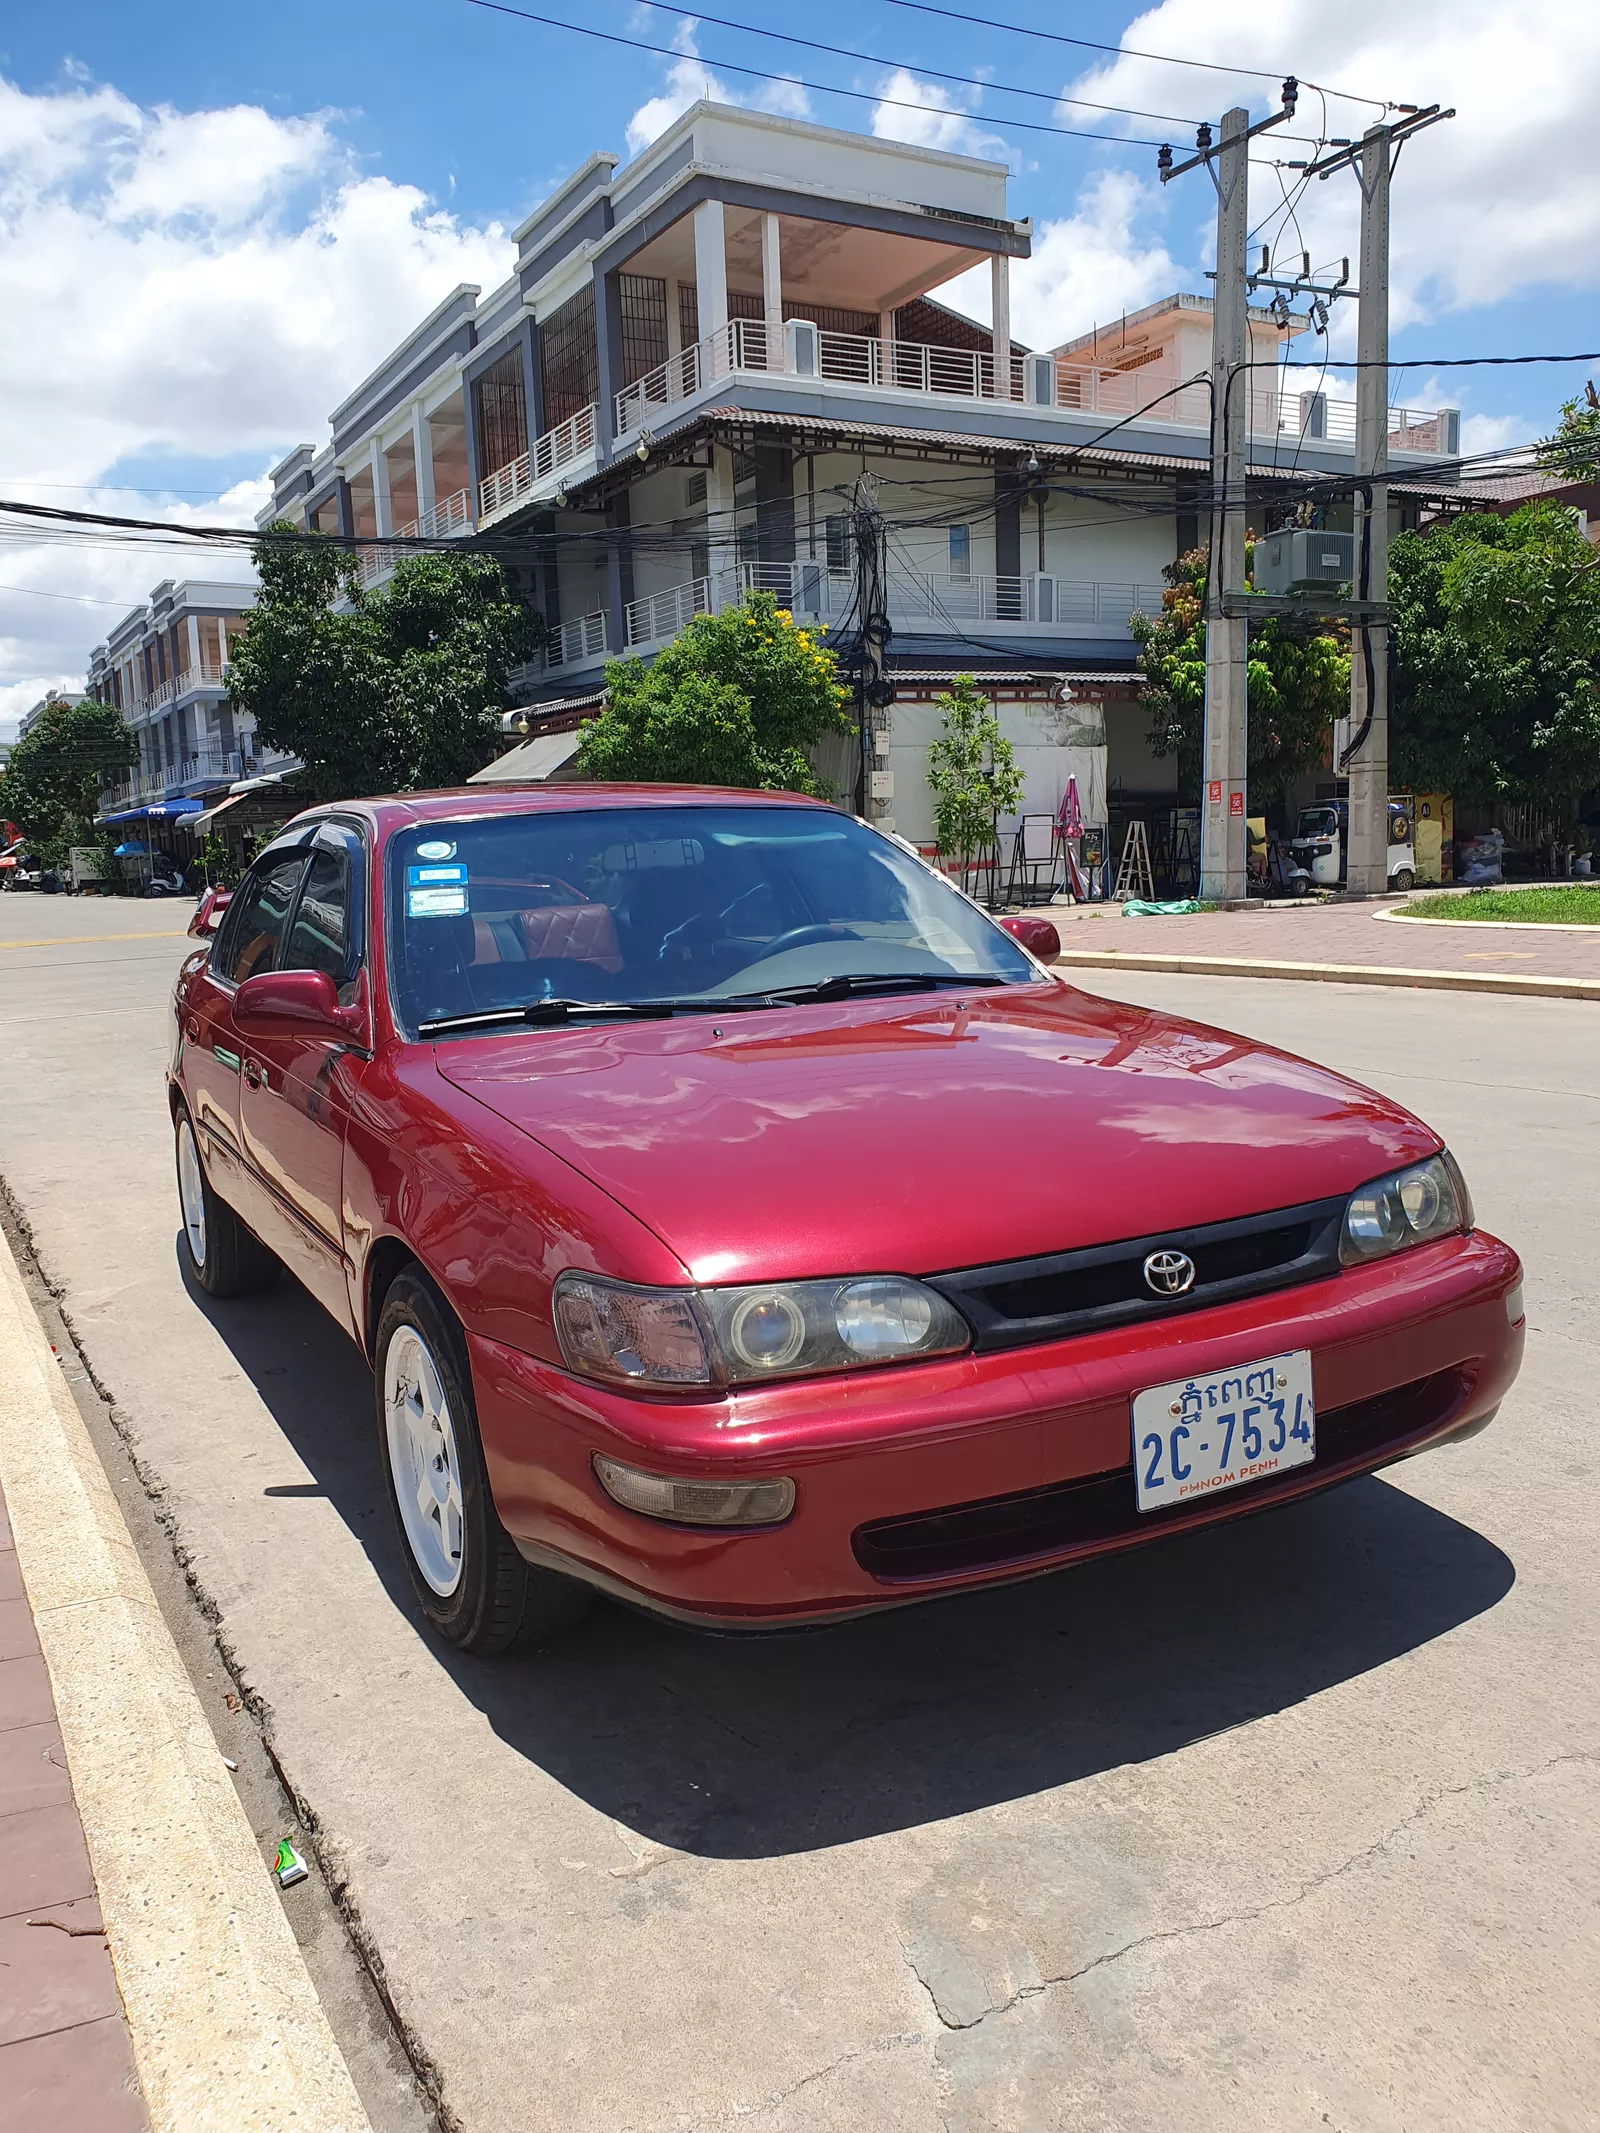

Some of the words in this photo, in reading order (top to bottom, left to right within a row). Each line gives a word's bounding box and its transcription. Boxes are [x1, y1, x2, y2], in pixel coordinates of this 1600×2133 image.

[1179, 1367, 1275, 1424] ភ្នំពេញ
[1142, 1393, 1311, 1490] 2C-7534
[1179, 1472, 1236, 1496] PHNOM
[1240, 1458, 1279, 1478] PENH
